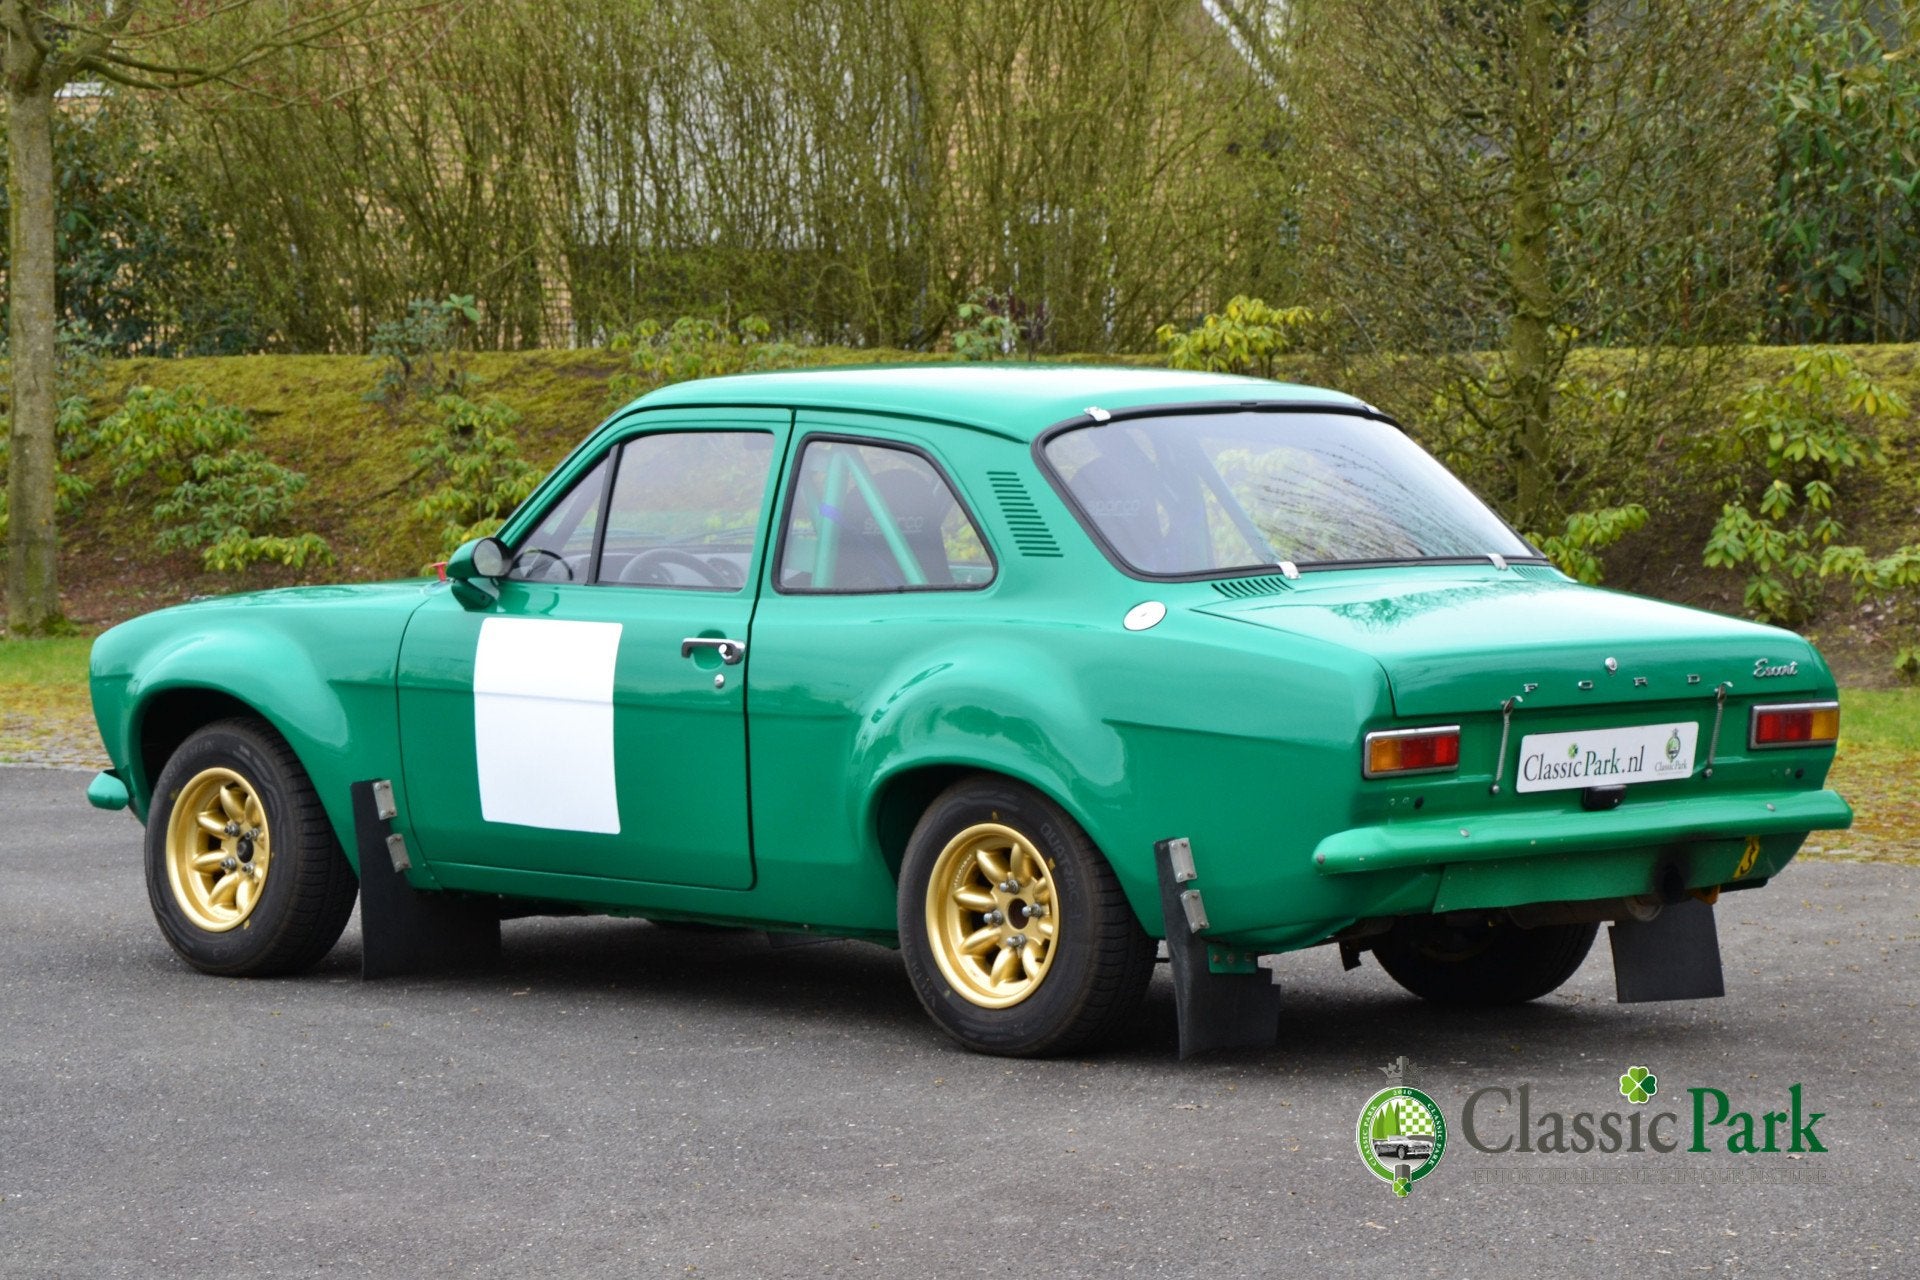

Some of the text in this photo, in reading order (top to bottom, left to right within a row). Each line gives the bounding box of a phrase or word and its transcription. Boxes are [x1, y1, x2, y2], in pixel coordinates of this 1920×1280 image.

[1753, 658, 1798, 678] Escort
[1523, 673, 1701, 693] FORD
[1524, 745, 1646, 781] ClassicPark.nl
